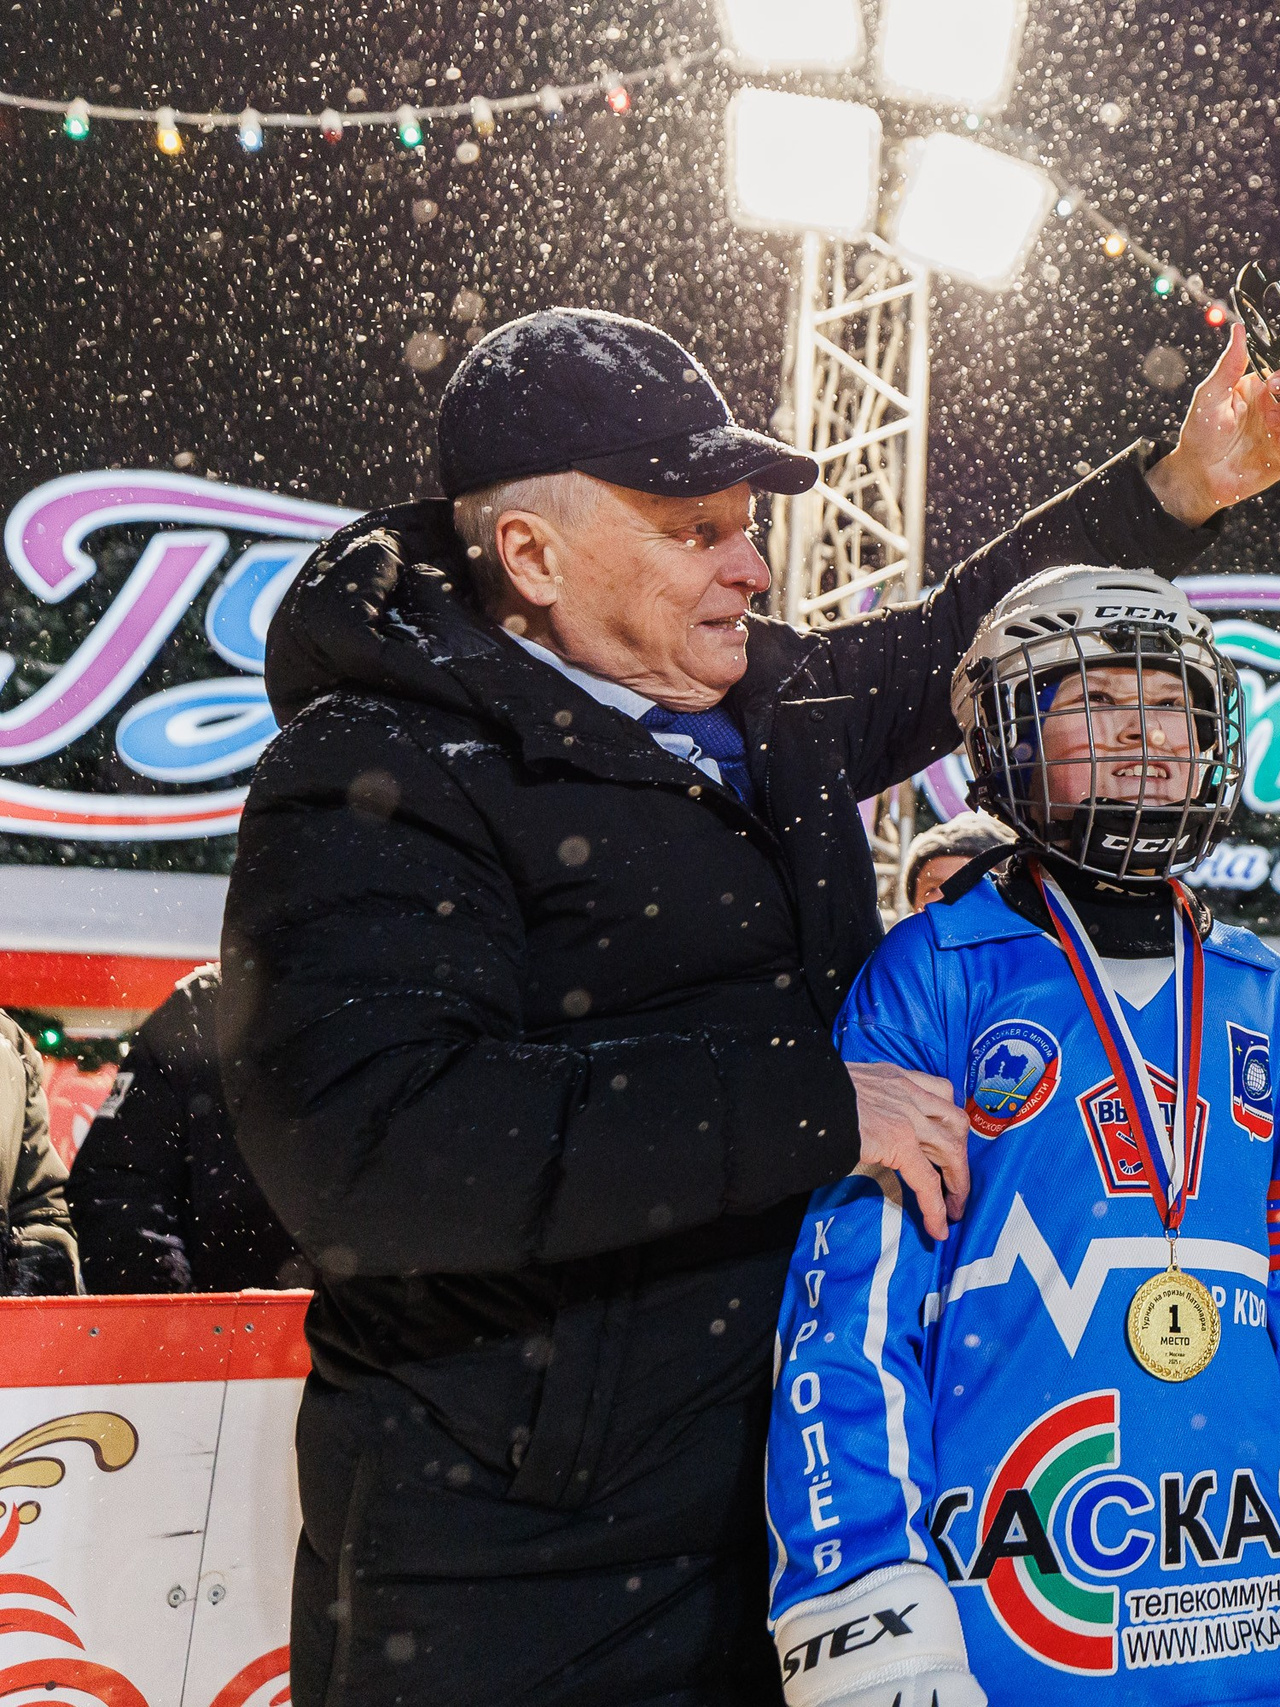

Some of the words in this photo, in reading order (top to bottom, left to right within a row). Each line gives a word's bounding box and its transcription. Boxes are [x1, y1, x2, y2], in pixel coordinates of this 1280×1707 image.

[1094, 605, 1179, 624] CCM
[1101, 833, 1191, 854] CCM
[1029, 1033, 1053, 1057] МЯЧОМ
[1141, 1301, 1156, 1331] Турнир
[1154, 1293, 1163, 1304] на
[1162, 1289, 1186, 1298] призы
[1185, 1292, 1207, 1332] Патриарха
[1168, 1304, 1182, 1334] 1
[1160, 1336, 1191, 1347] место
[789, 1216, 843, 1578] КОРОЛЁВ
[782, 1602, 920, 1686] STEX
